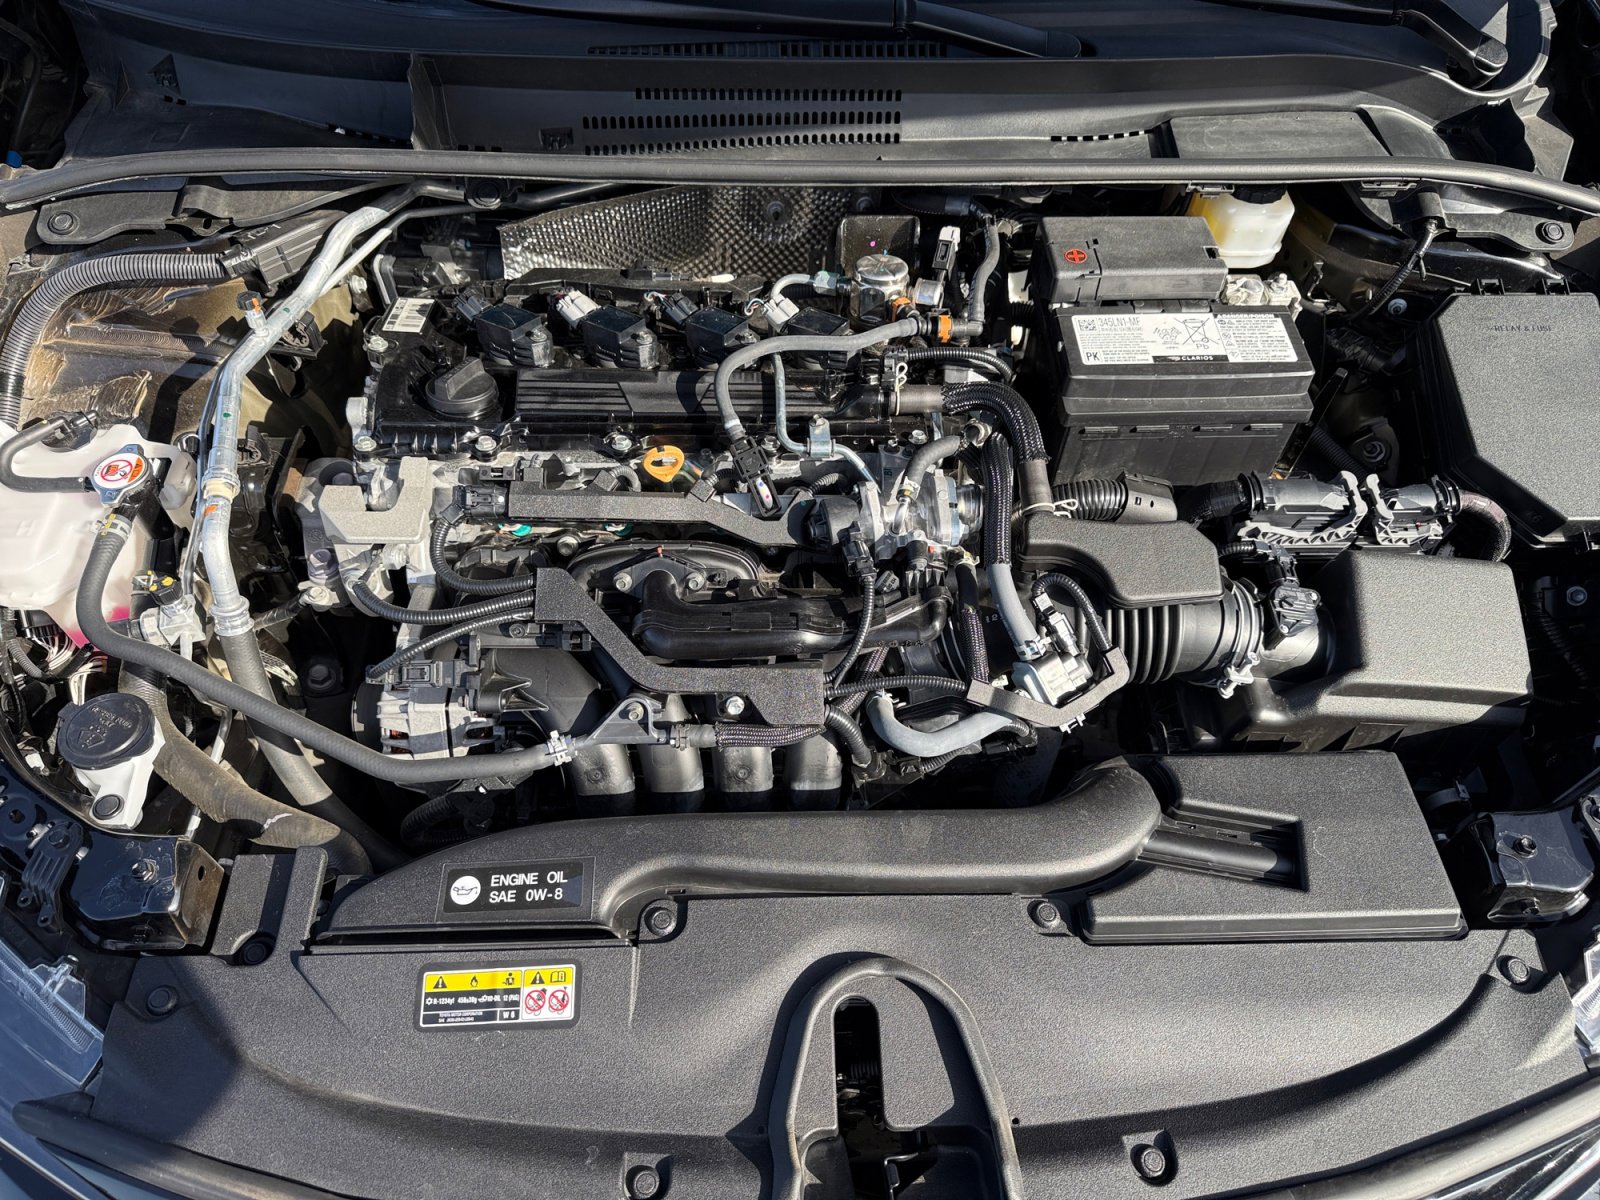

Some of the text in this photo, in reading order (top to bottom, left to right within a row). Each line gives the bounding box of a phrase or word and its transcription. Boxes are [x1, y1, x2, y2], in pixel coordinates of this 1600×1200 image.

[1086, 351, 1100, 362] PK
[490, 870, 568, 887] ENGINE OIL
[489, 887, 563, 903] SAE 0W-8
